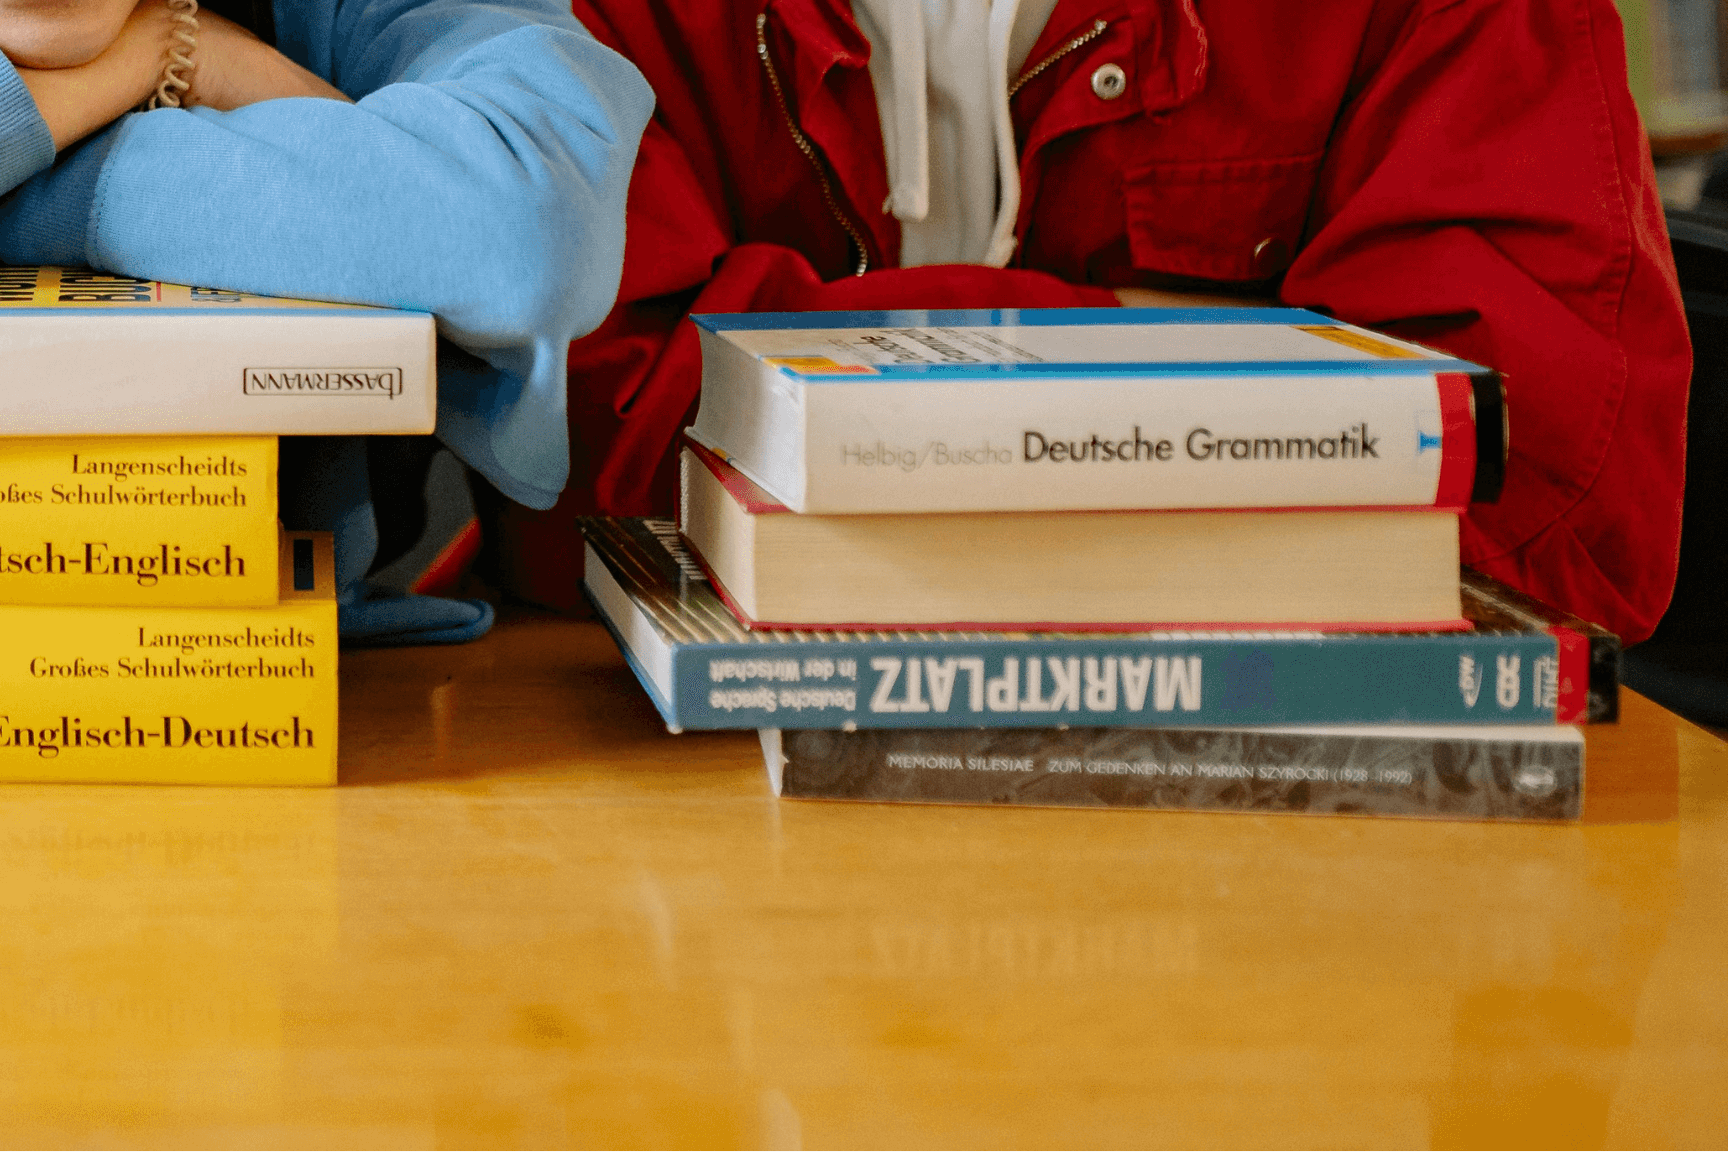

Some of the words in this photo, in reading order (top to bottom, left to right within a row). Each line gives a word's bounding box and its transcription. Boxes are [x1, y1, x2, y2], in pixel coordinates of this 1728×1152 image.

[840, 439, 1013, 473] Helbig/Buscha
[1022, 426, 1174, 463] Deutsche
[1185, 423, 1380, 461] Grammatik
[71, 454, 248, 482] Langenscheidts
[51, 483, 248, 508] Schulwörterbuch
[137, 627, 315, 654] Langenscheidts
[29, 657, 109, 679] Großes
[117, 657, 315, 680] Schulwörterbuch
[709, 658, 800, 682] Wirtschaft
[804, 659, 836, 681] der
[840, 659, 857, 680] in
[872, 657, 1203, 714] MARKTPLATZ
[710, 688, 777, 714] Sprache
[779, 689, 857, 712] Deutsche
[888, 755, 963, 770] MEMORIA
[966, 756, 1034, 772] SILESIAE
[1048, 759, 1082, 774] ZUM
[1086, 760, 1165, 776] GEDENKEN
[1170, 763, 1193, 777] AN
[1198, 763, 1254, 779] MARIAN
